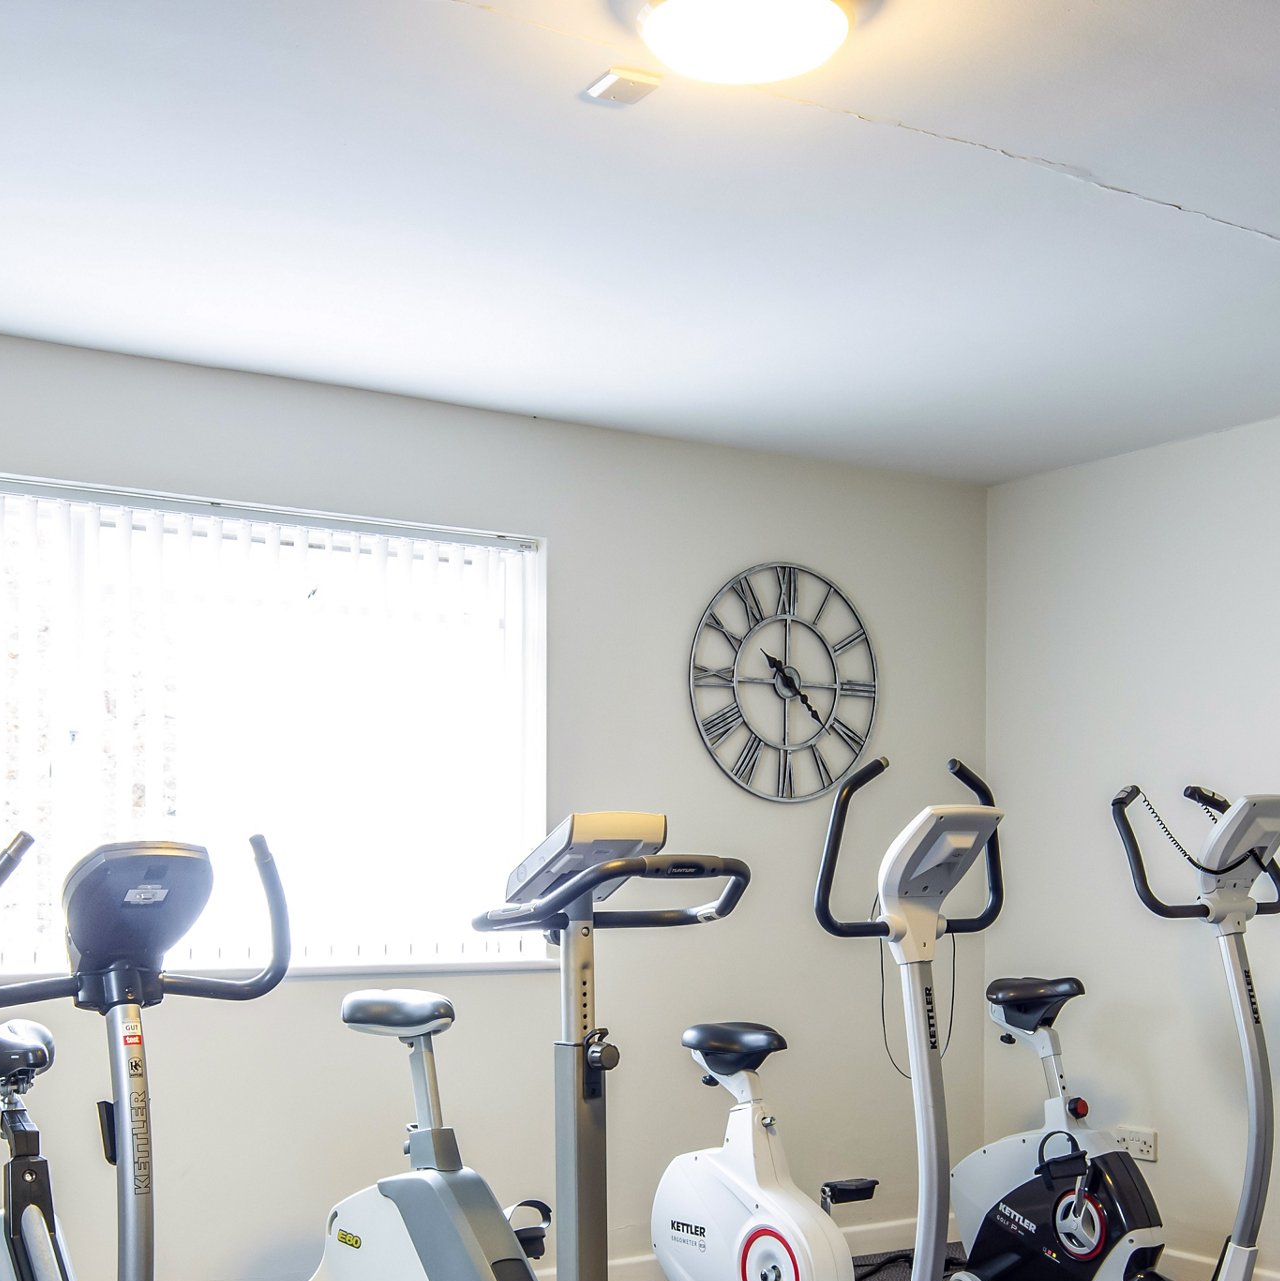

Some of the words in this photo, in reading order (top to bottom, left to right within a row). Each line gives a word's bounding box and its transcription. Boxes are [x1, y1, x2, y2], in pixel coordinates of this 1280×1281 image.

[924, 986, 938, 1050] KETTLER
[1244, 969, 1261, 1025] KETTLER
[129, 1090, 150, 1195] KETTLER
[337, 1229, 362, 1249] E60
[670, 1219, 706, 1238] KETTLER
[998, 1202, 1037, 1234] KETTLER
